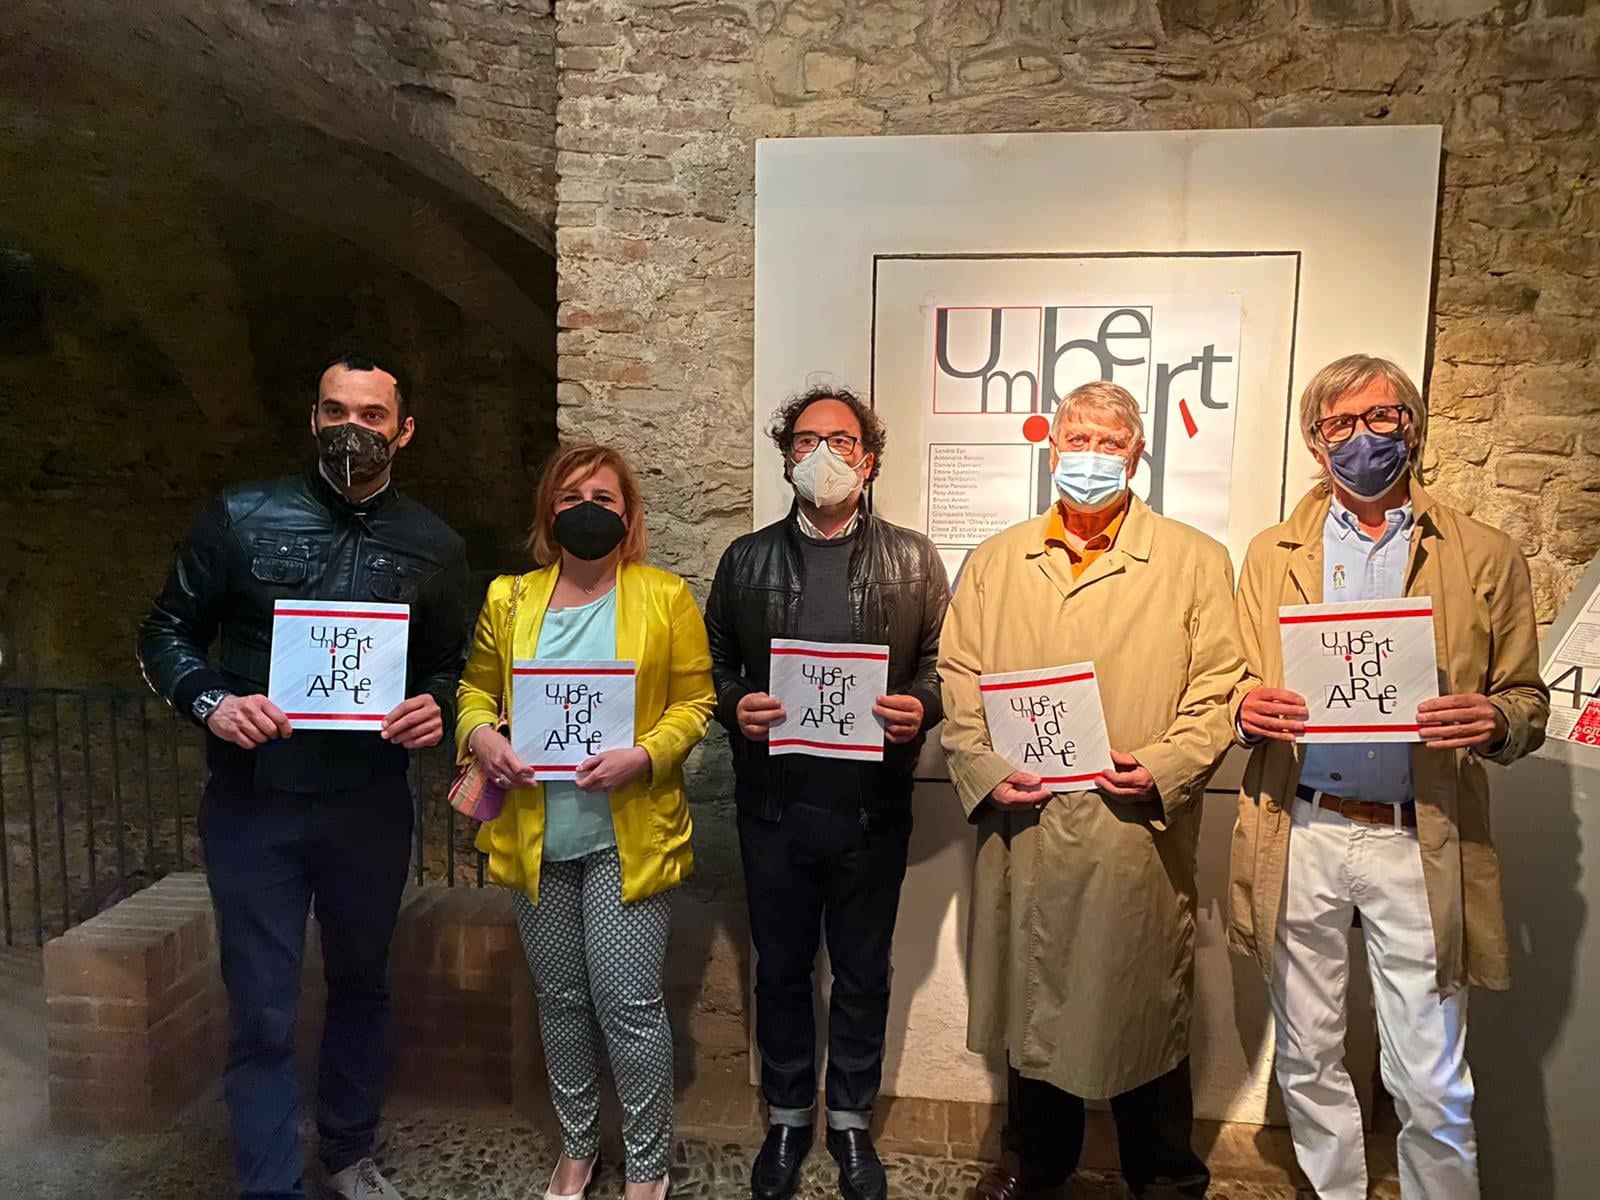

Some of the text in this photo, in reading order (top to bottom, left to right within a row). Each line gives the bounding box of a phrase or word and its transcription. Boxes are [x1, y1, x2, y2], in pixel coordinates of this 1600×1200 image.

[311, 626, 374, 648] Umbert
[1321, 630, 1394, 655] Umbert
[306, 670, 371, 704] ARte
[802, 664, 856, 686] Umbert
[545, 684, 603, 705] Umbert
[1010, 695, 1067, 718] Umbert
[1326, 678, 1397, 714] ARte
[800, 705, 855, 736] ARte
[544, 724, 602, 755] ARte
[1023, 736, 1075, 767] ARte
